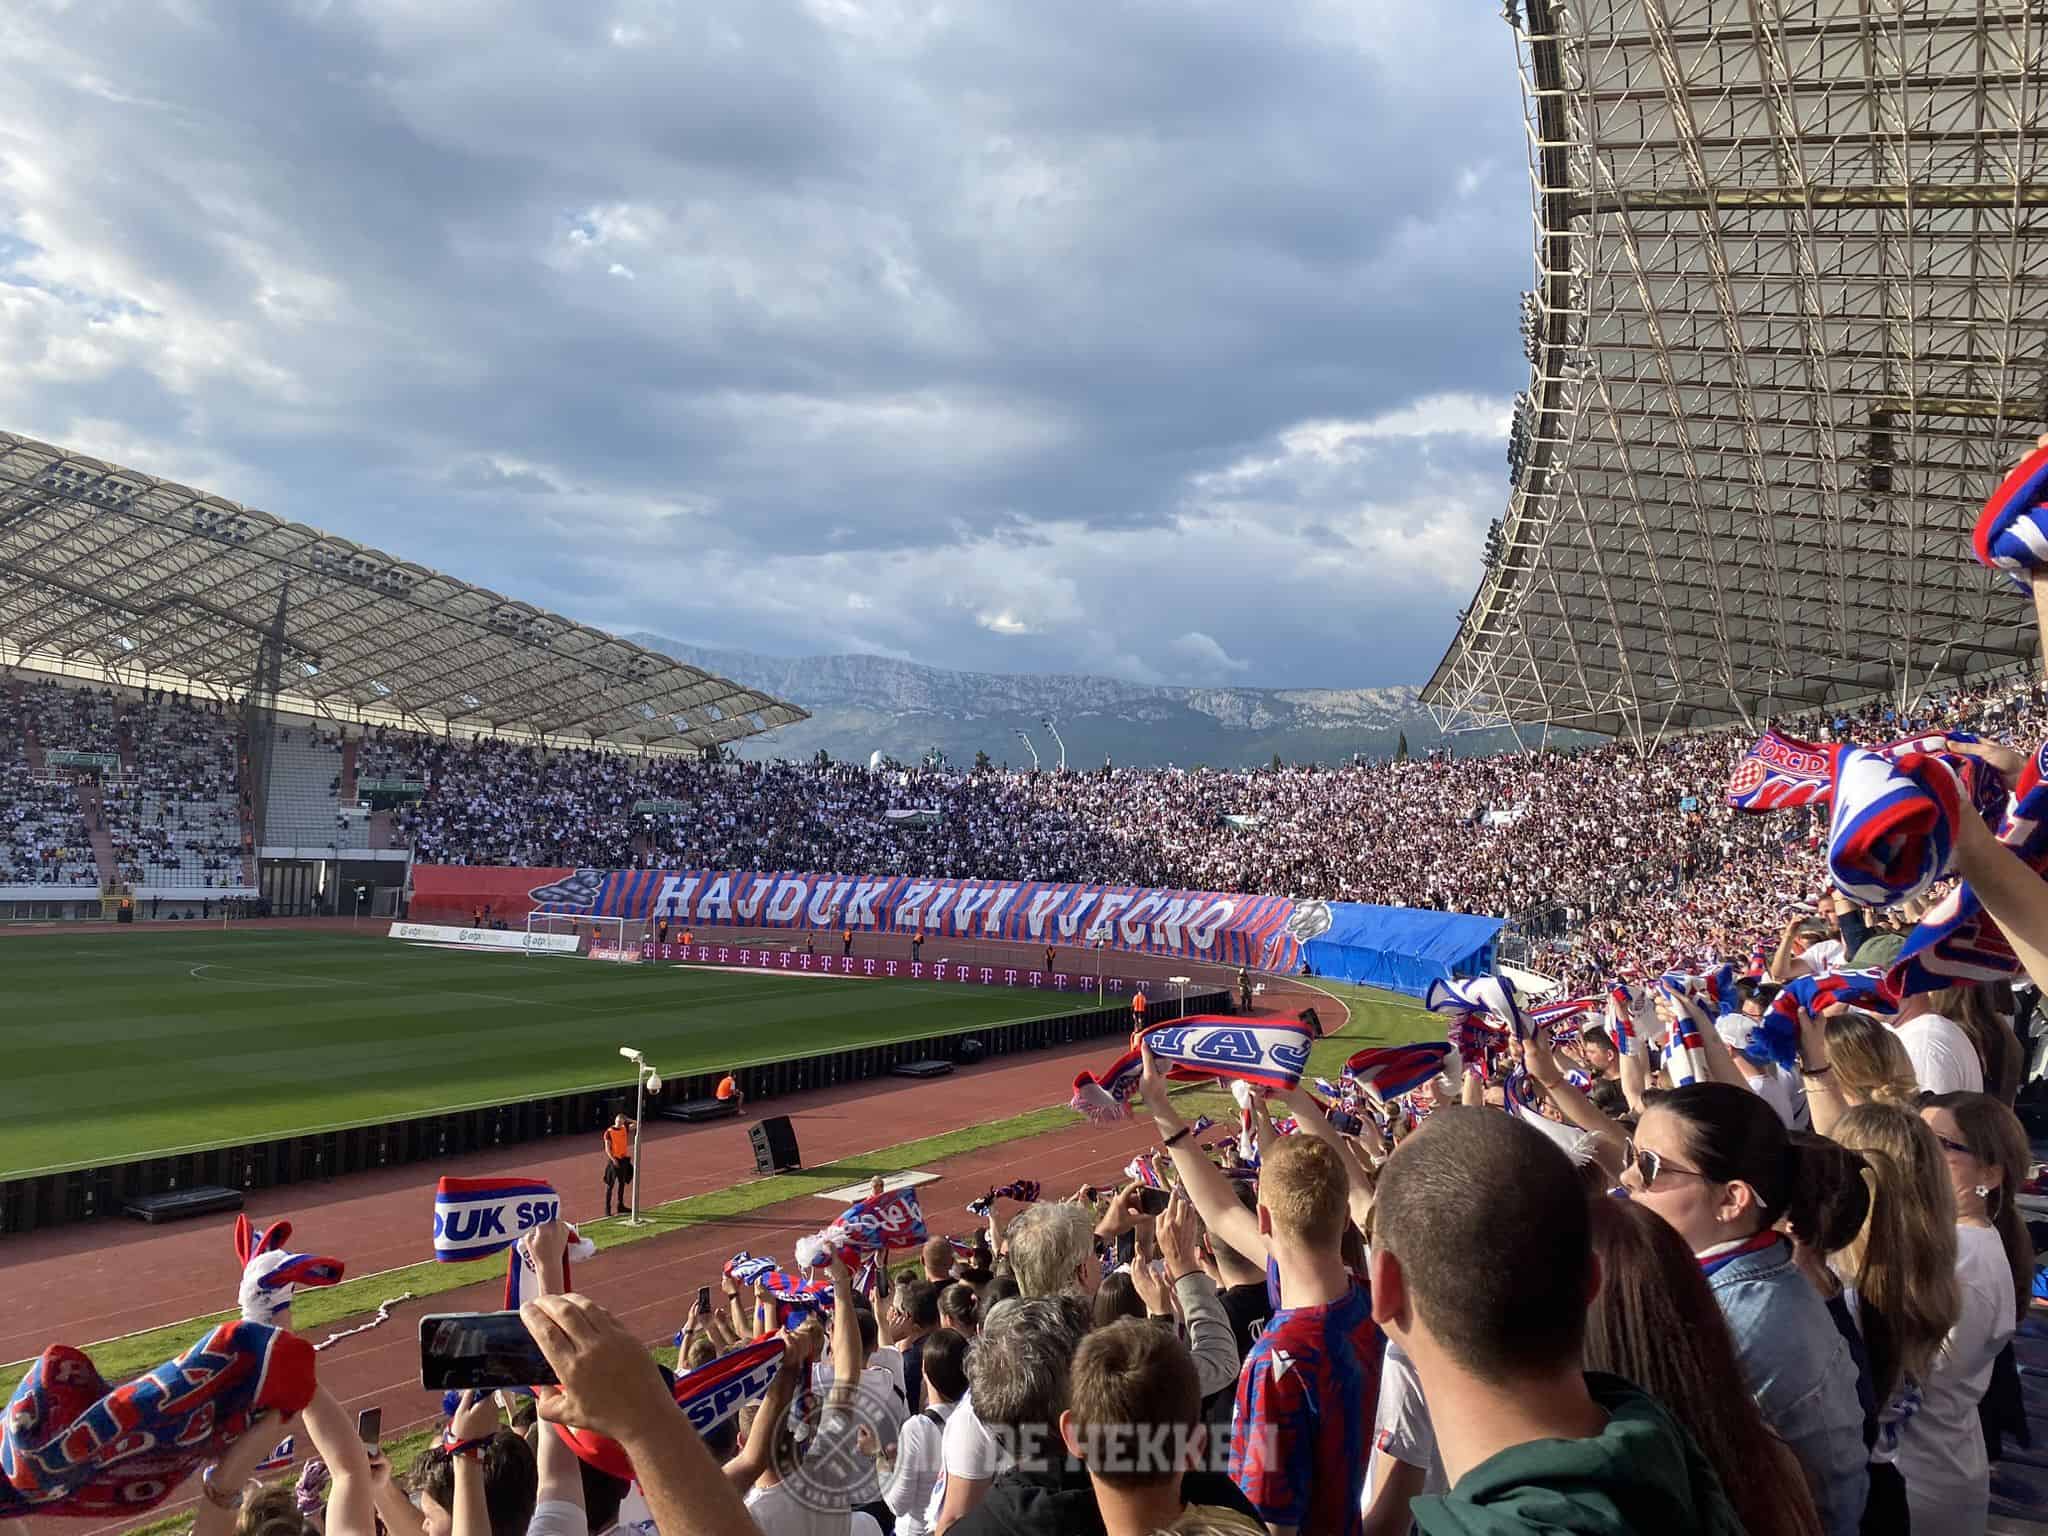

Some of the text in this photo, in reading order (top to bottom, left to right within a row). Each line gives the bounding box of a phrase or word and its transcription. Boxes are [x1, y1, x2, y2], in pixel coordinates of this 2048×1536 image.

[1756, 735, 1831, 773] TORCID
[654, 876, 888, 925] HAJDUK
[643, 943, 653, 957] T
[662, 943, 672, 958] T
[680, 945, 690, 960] T
[699, 946, 709, 961] T
[718, 948, 728, 962] T
[739, 950, 750, 965] T
[759, 951, 769, 966] T
[780, 952, 790, 968] T
[800, 953, 810, 969] T
[821, 955, 831, 971] T
[842, 957, 853, 973] T
[864, 959, 874, 975] T
[886, 960, 897, 977] T
[911, 962, 922, 978] T
[934, 964, 945, 980] T
[957, 966, 969, 982] T
[980, 968, 992, 984] T
[1004, 970, 1017, 985] T
[1029, 971, 1041, 987] T
[1054, 974, 1067, 990] T
[1080, 976, 1093, 991] T
[1110, 978, 1122, 992] T
